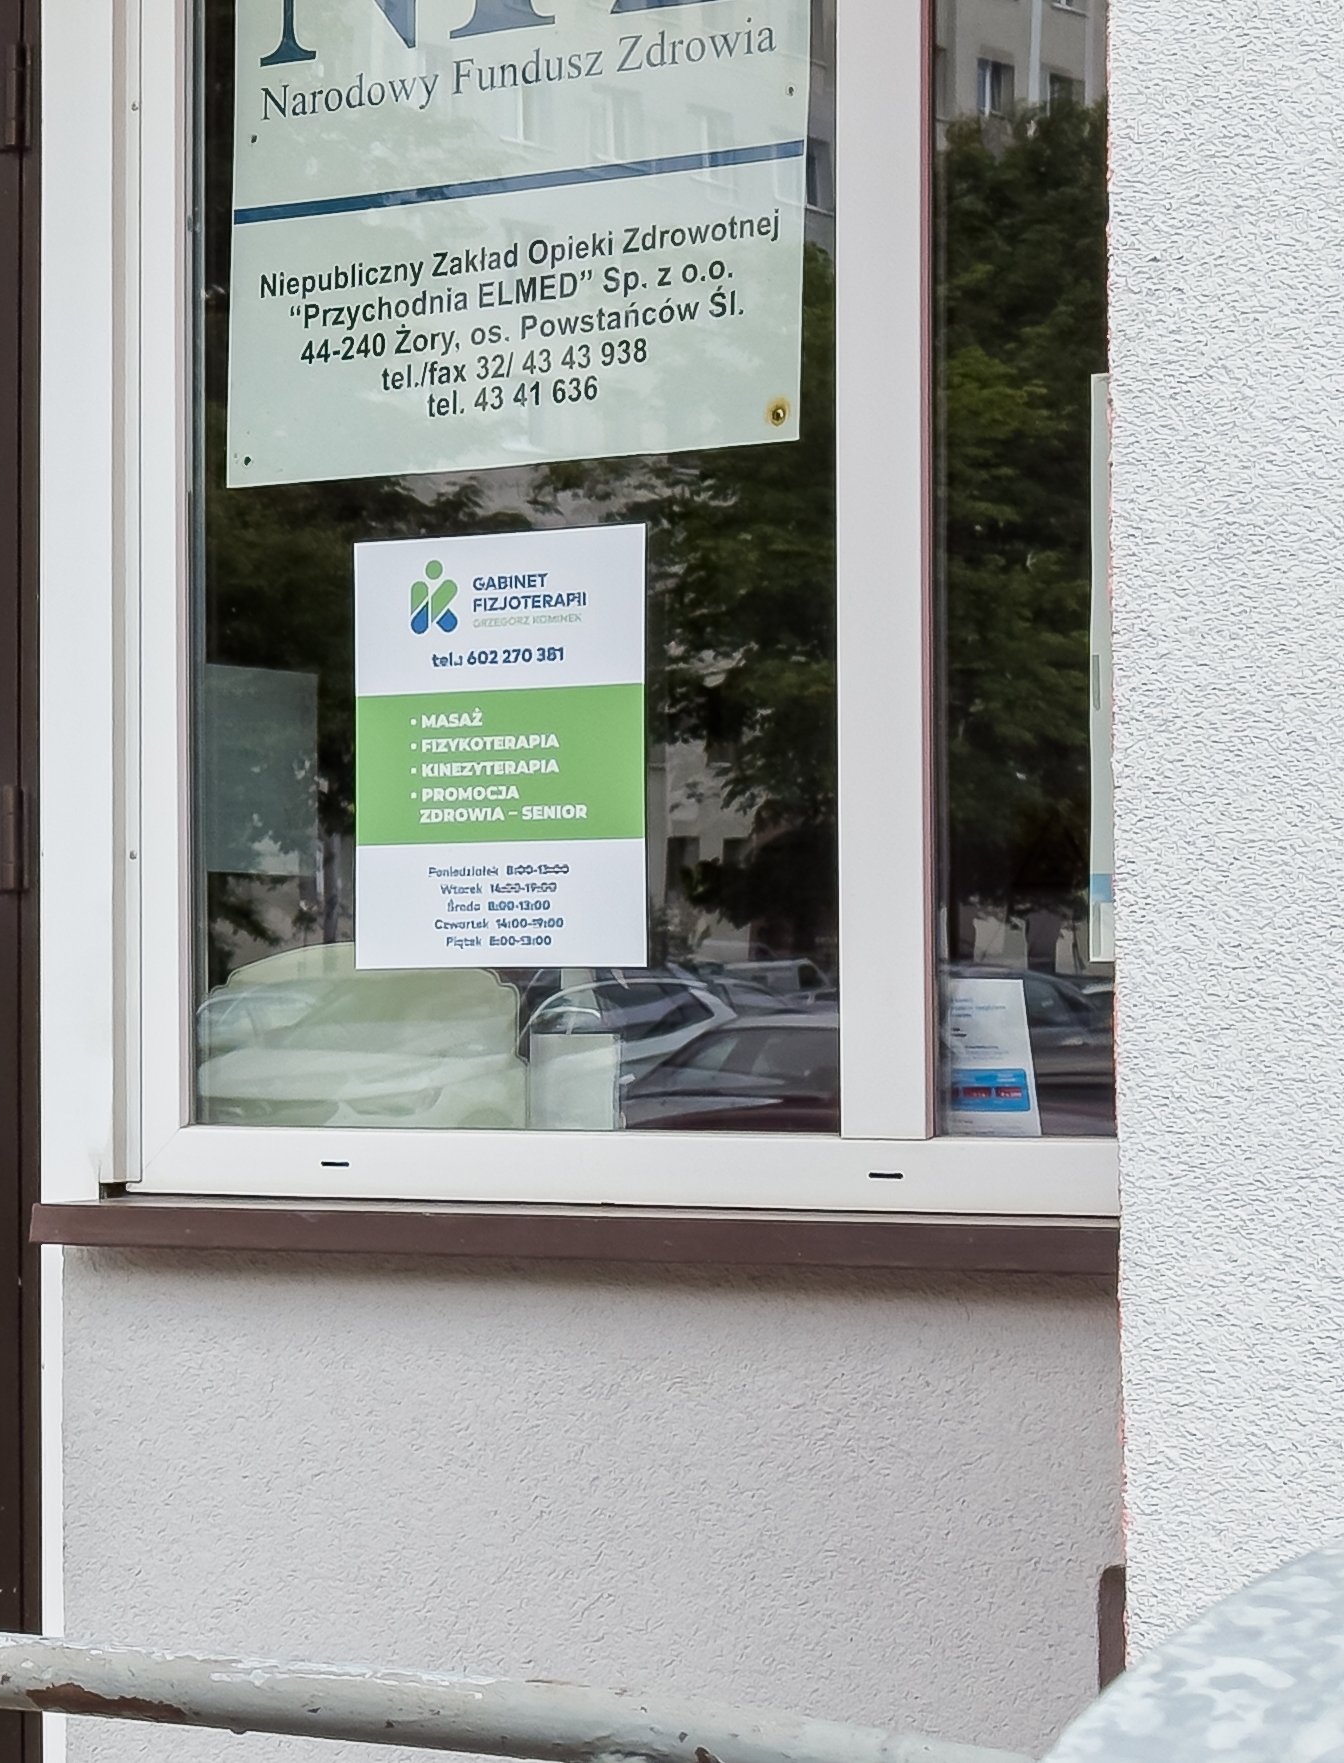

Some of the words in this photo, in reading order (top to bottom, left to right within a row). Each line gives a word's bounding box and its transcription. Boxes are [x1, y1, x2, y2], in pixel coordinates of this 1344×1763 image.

[260, 72, 439, 121] Narodowy
[452, 48, 603, 95] Fundusz
[616, 17, 776, 72] Zdrowia
[260, 260, 424, 299] Niepubliczny
[431, 242, 518, 277] Zakład
[528, 231, 613, 269] Opieki
[622, 208, 780, 254] Zdrowotnej
[603, 266, 647, 298] Sp.
[658, 267, 672, 287] z
[682, 260, 734, 284] o.o.
[300, 332, 386, 364] 44-240
[394, 324, 461, 356] Żory,
[470, 324, 510, 346] os.
[520, 298, 700, 340] Powstańców
[709, 285, 744, 318] Śl.
[382, 361, 467, 391] tel./fax
[476, 351, 514, 380] 32/
[522, 348, 552, 374] 43
[561, 344, 591, 370] 43
[601, 337, 647, 367] 938
[427, 389, 465, 418] tel.
[474, 385, 504, 411] 43
[513, 380, 540, 407] 41
[552, 375, 598, 404] 636
[472, 572, 548, 591] GABINET
[473, 592, 587, 613] FIZJOTERAPII
[467, 650, 499, 666] 602
[502, 648, 533, 664] 270
[421, 706, 483, 728] MASAŻ
[421, 734, 559, 753] FIZYKOTERAPIA
[421, 758, 559, 777] KINEZYTERAPIA
[422, 785, 519, 802] PROMOCJA
[419, 806, 505, 823] ZDROWIA
[522, 804, 587, 820] SENIOR
